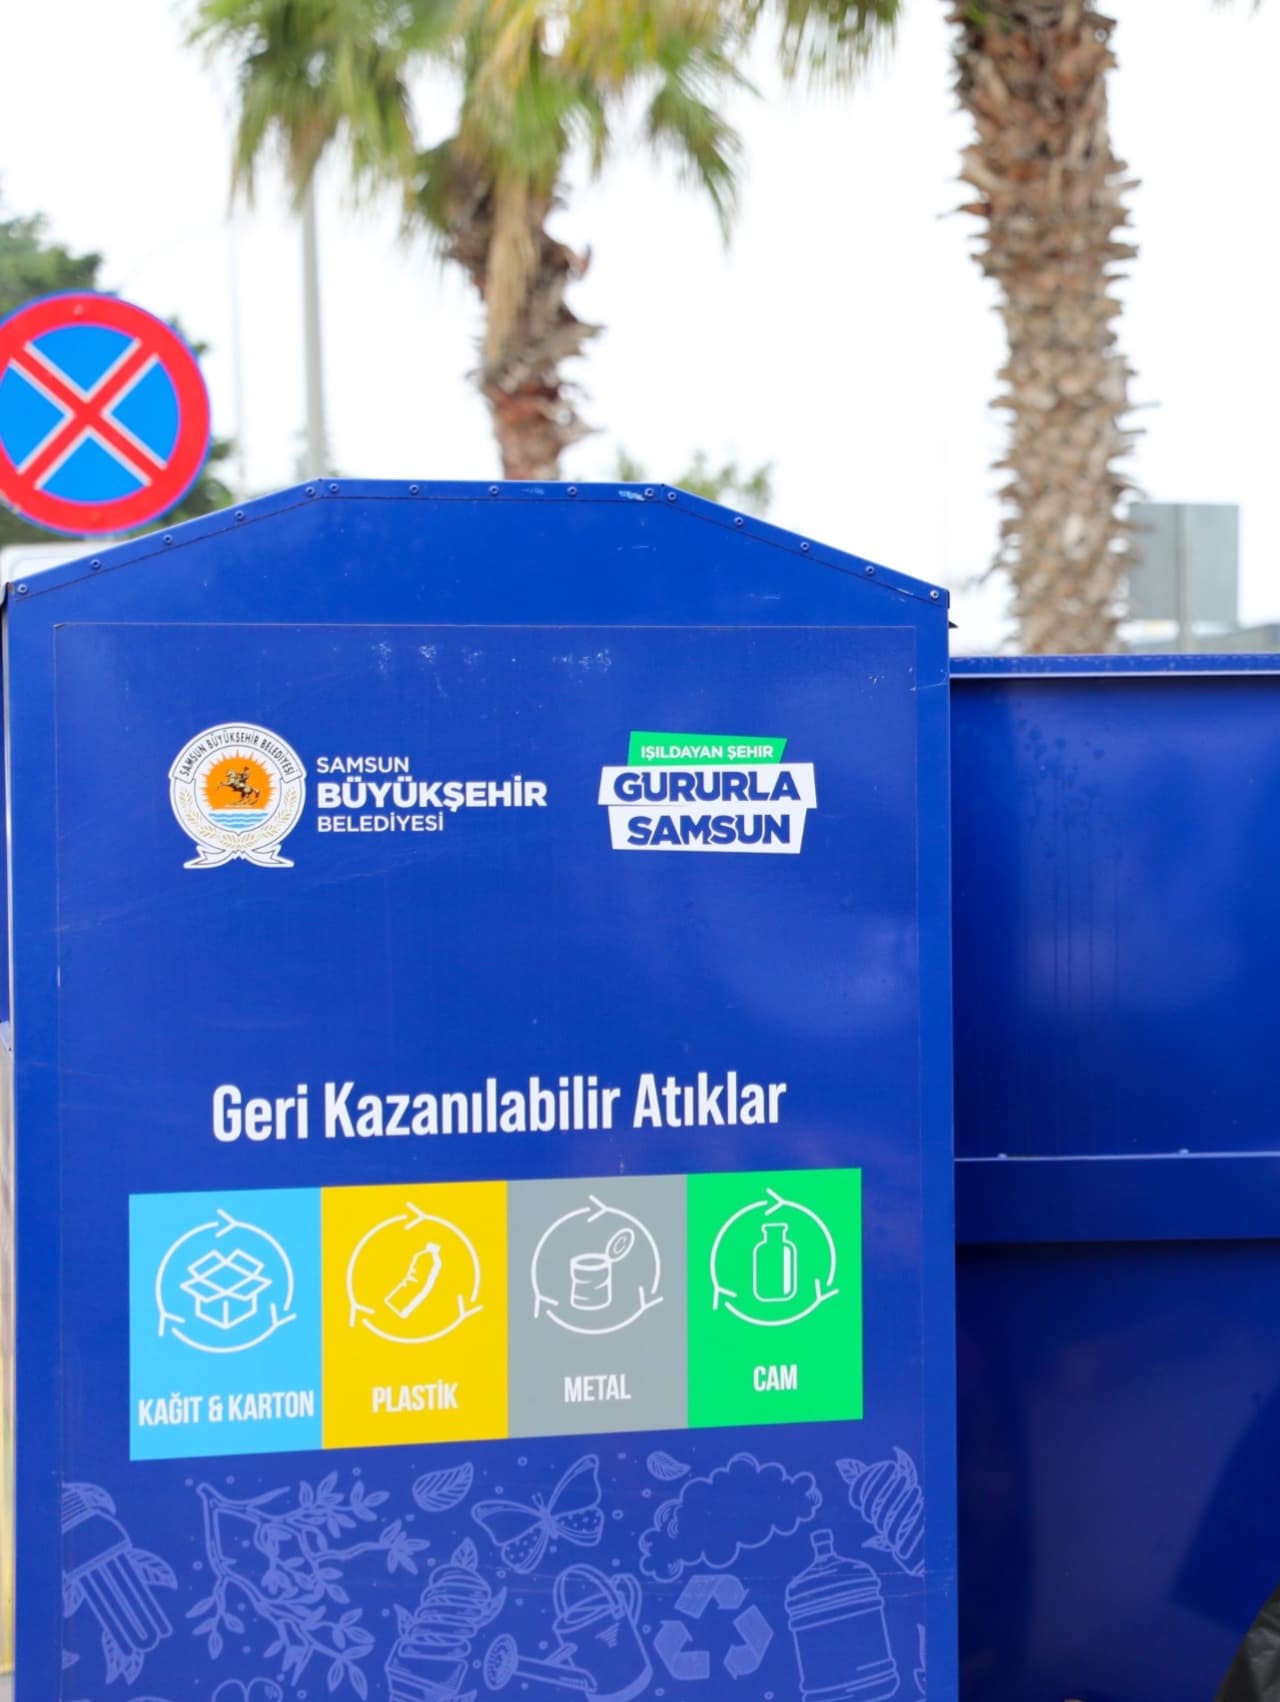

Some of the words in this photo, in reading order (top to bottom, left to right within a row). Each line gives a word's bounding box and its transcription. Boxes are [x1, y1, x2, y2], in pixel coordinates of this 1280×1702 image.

[180, 744, 208, 777] SAMSUN
[260, 738, 296, 776] BELEDİYESİ
[316, 756, 410, 774] SAMSUN
[639, 745, 724, 761] IŞILDAYAN
[727, 744, 774, 761] ŞEHİR
[317, 775, 548, 813] BÜYÜKŞEHİR
[614, 771, 801, 802] GURURLA
[317, 811, 444, 833] BELEDİYESİ
[627, 814, 791, 846] SAMSUN
[212, 1084, 309, 1142] Geri
[324, 1075, 621, 1139] Kazanılabilir
[632, 1071, 787, 1128] Atıklar
[564, 1374, 632, 1403] METAL
[753, 1364, 798, 1392] CAM
[138, 1392, 203, 1427] KAĞIT
[208, 1394, 224, 1423] &
[228, 1390, 315, 1422] KARTON
[371, 1379, 459, 1414] PLASTİK
